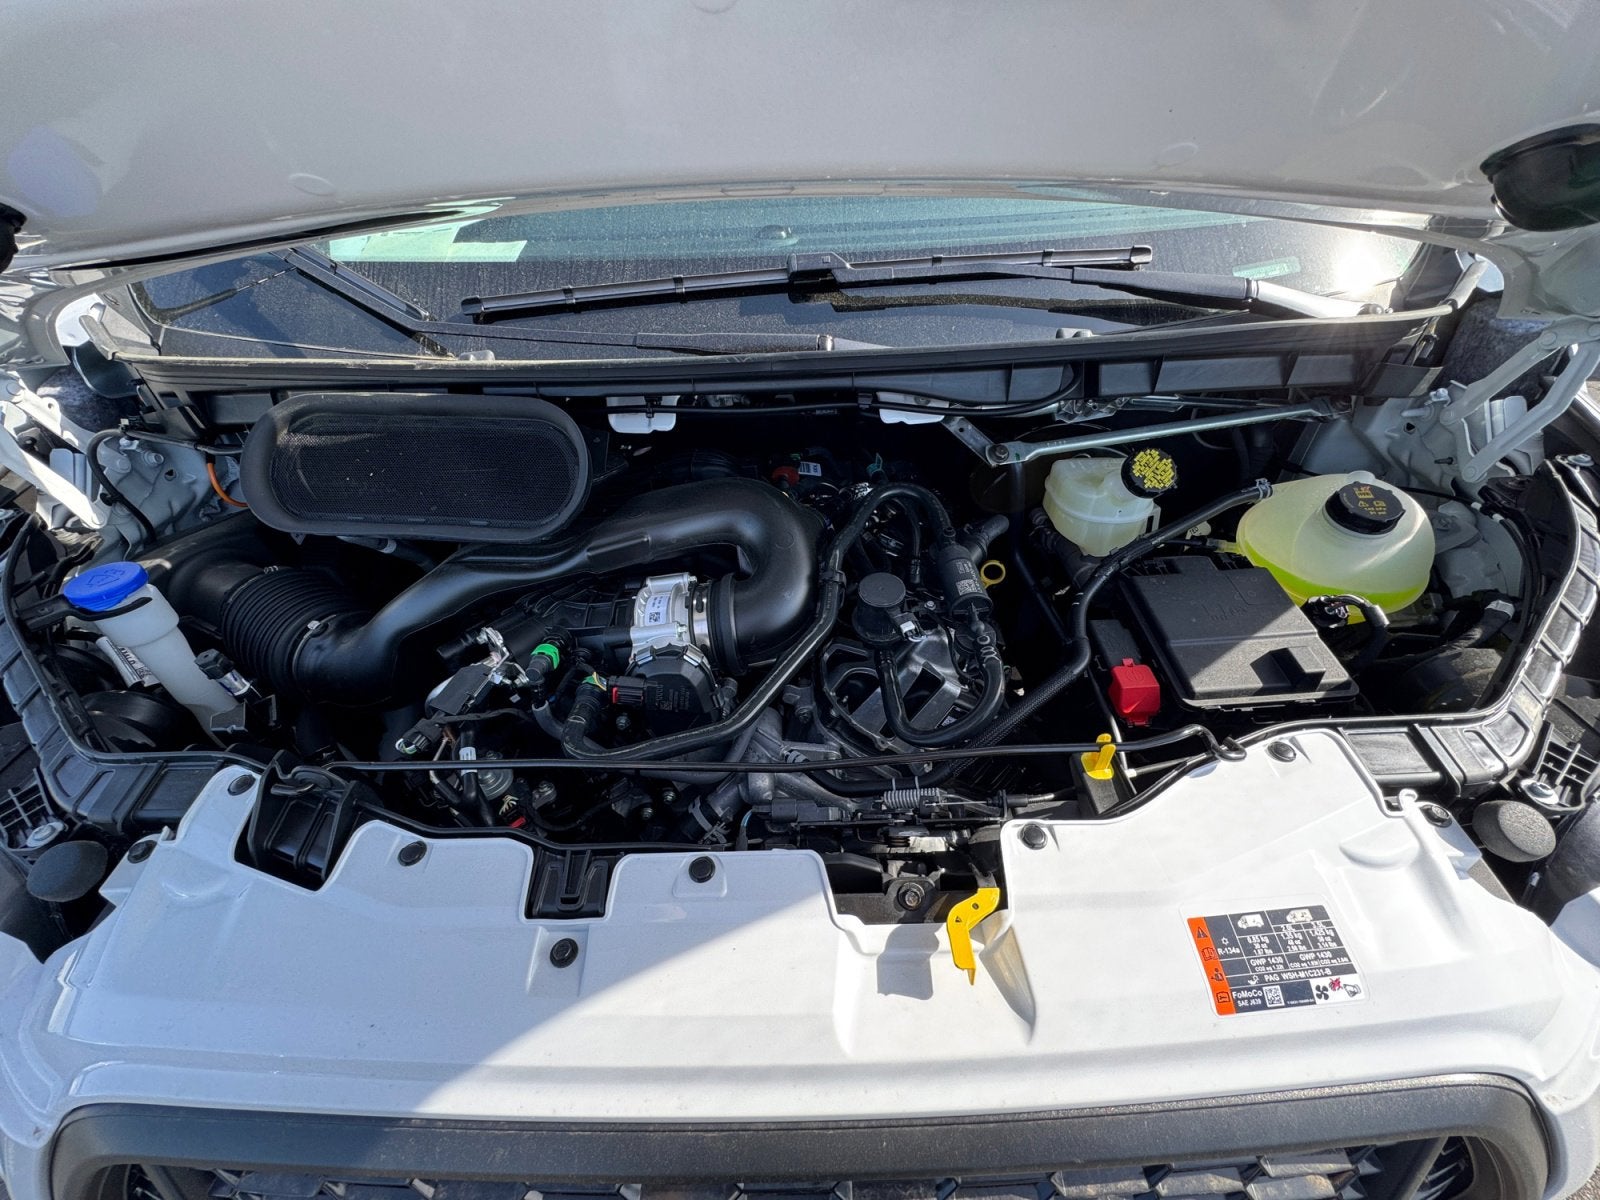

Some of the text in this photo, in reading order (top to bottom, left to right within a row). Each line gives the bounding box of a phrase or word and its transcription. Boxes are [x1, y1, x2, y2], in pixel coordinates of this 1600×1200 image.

[1218, 946, 1241, 956] R-134a
[1299, 951, 1333, 961] GWP 1430
[1250, 957, 1284, 967] GWP 1430
[1265, 974, 1280, 983] PAG
[1232, 990, 1263, 1000] FoMoCo
